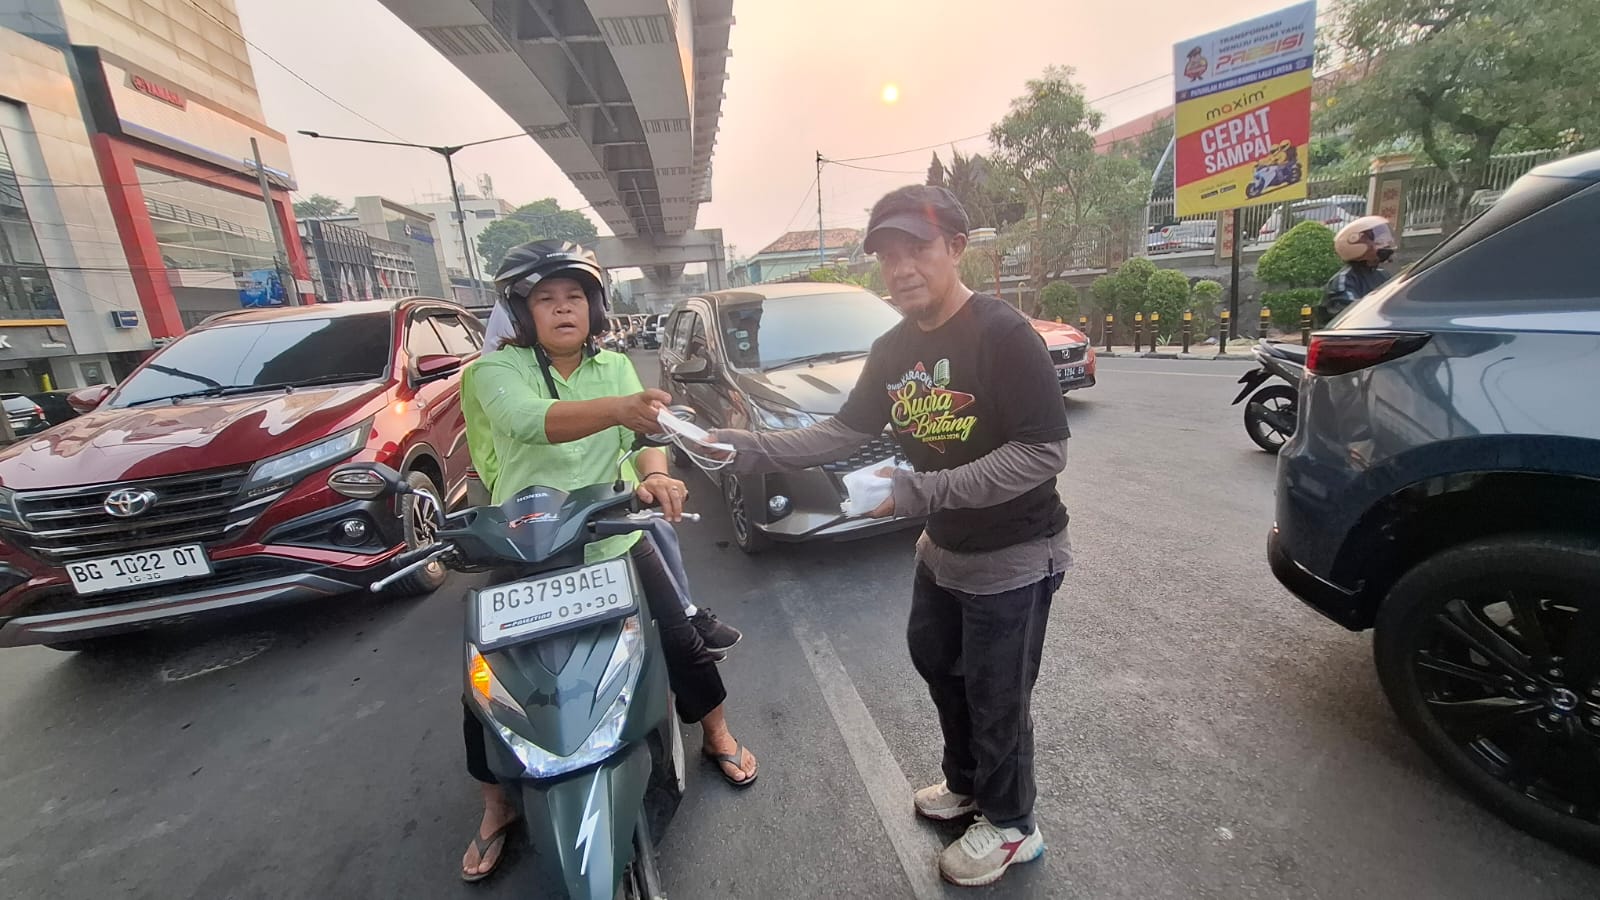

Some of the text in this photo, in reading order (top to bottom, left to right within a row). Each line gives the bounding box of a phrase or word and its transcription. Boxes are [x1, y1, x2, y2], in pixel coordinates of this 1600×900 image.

[1206, 89, 1265, 121] maxim
[1201, 106, 1270, 154] CEPAT
[1204, 135, 1272, 174] SAMPAI
[901, 370, 933, 389] KARAOKE
[892, 380, 952, 427] Suara
[516, 492, 549, 503] HONDA
[72, 548, 196, 582] BG 1022 OT
[493, 567, 616, 613] BG3799AEL
